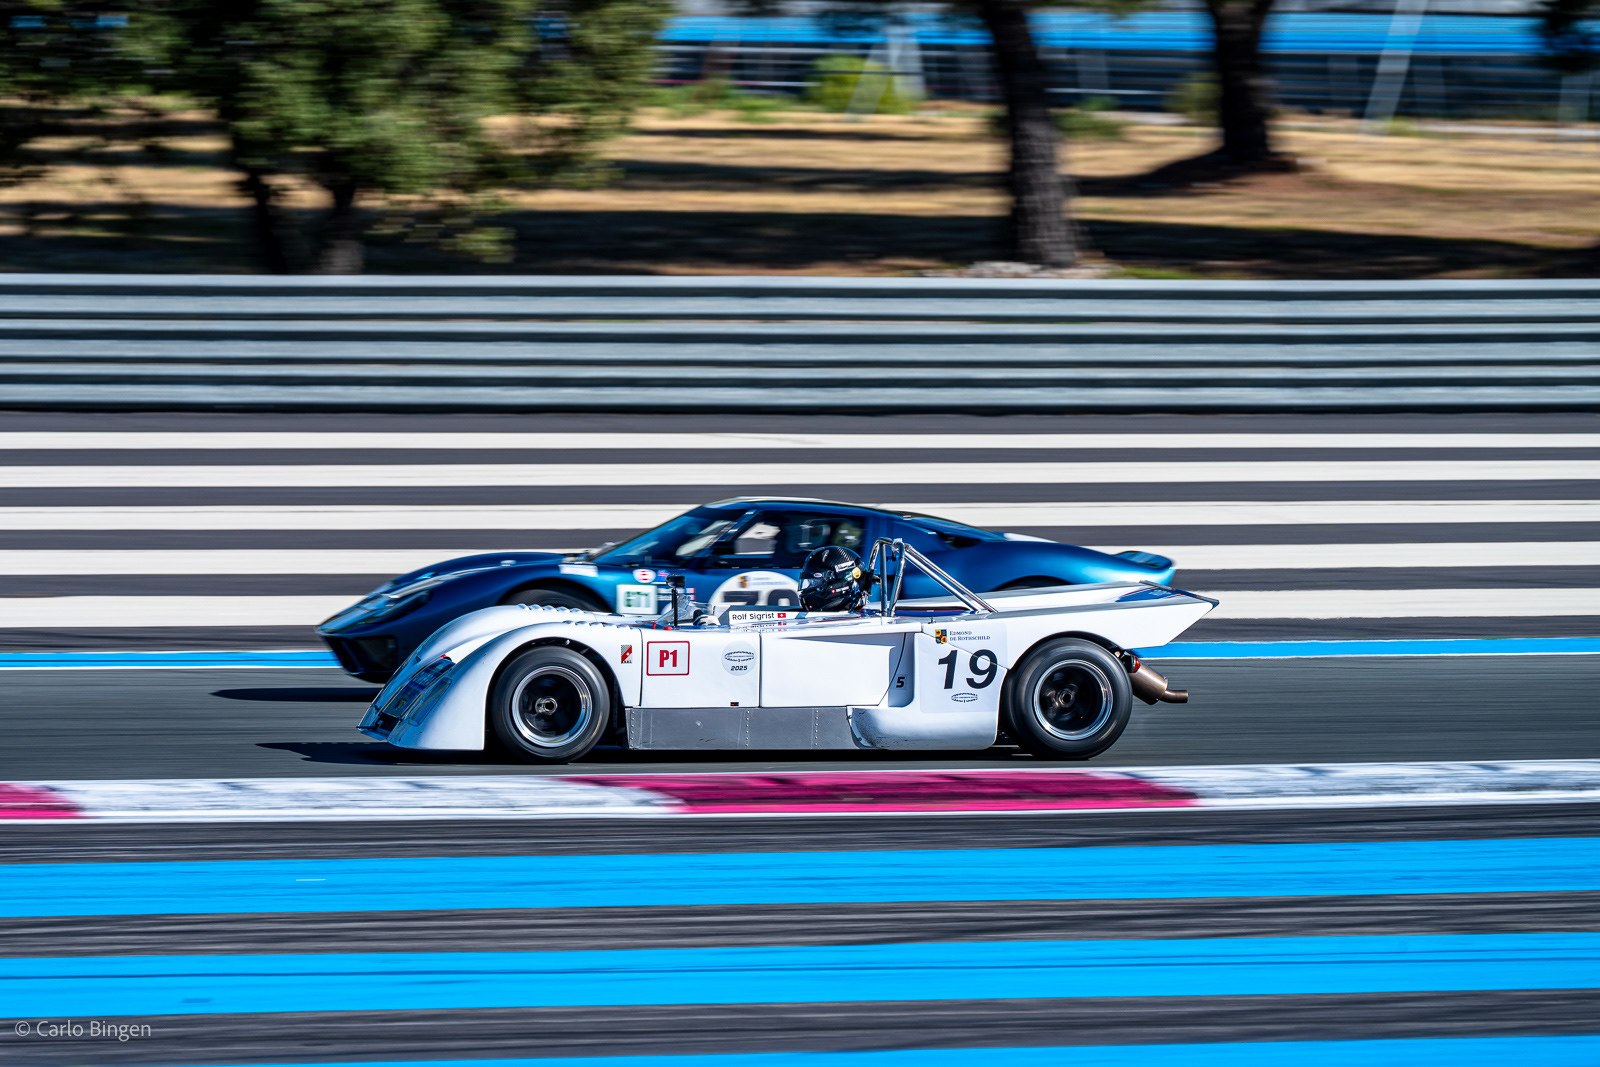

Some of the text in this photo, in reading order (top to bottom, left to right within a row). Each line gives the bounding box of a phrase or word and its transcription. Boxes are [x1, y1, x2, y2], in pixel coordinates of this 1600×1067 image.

[732, 612, 775, 621] Rolf Sigrist
[659, 649, 678, 668] P1
[938, 649, 998, 690] 19
[896, 676, 905, 688] 5
